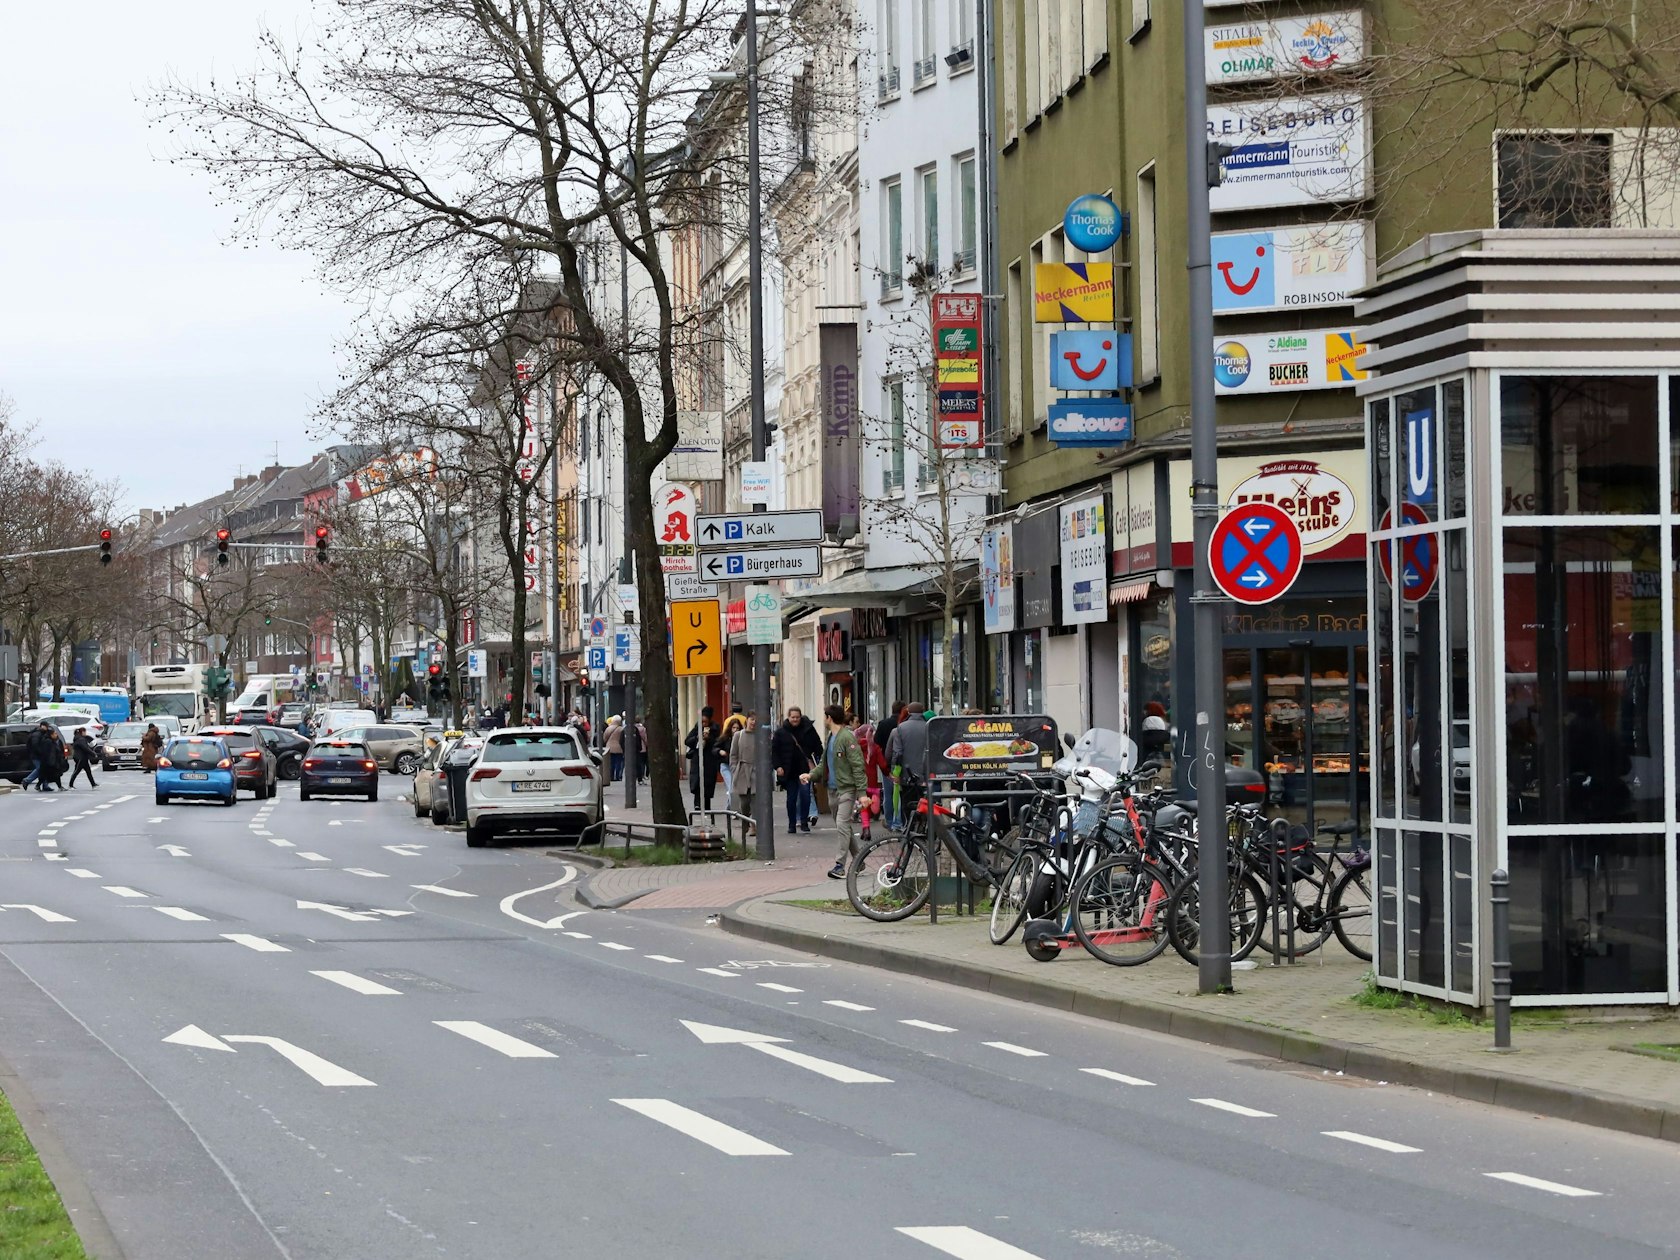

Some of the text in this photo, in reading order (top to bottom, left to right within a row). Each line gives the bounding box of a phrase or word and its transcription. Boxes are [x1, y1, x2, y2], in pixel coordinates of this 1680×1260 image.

[1221, 57, 1274, 73] OLIMAR
[1206, 107, 1354, 135] REISEBÜRO
[1221, 143, 1341, 165] immermann Touristik
[1220, 167, 1351, 184] ww.zimmermanntouristik.com
[1071, 213, 1115, 226] Thomas
[1086, 224, 1114, 236] Cook
[1036, 279, 1114, 304] Neckermann
[1284, 291, 1346, 305] ROBINSON
[940, 299, 976, 316] LTU
[1277, 337, 1307, 348] Aldiana
[1214, 356, 1249, 366] Thomas
[1326, 347, 1367, 366] Neckermann
[1227, 365, 1249, 375] Cook
[1269, 364, 1308, 381] BUCHER
[826, 364, 855, 437] Kemp
[951, 429, 967, 437] ITS
[1409, 417, 1429, 496] U
[1116, 508, 1127, 535] Café
[1131, 501, 1153, 532] Bäckerei
[1297, 514, 1339, 532] stube
[729, 523, 775, 538] P Kalk
[660, 564, 692, 573] potheke
[730, 557, 803, 573] P Bürgerhaus
[674, 577, 698, 586] Gieße
[680, 585, 708, 595] Straße
[690, 612, 702, 628] U
[592, 650, 602, 667] P
[968, 721, 1013, 733] GAGAVA
[982, 761, 998, 769] KÖLN
